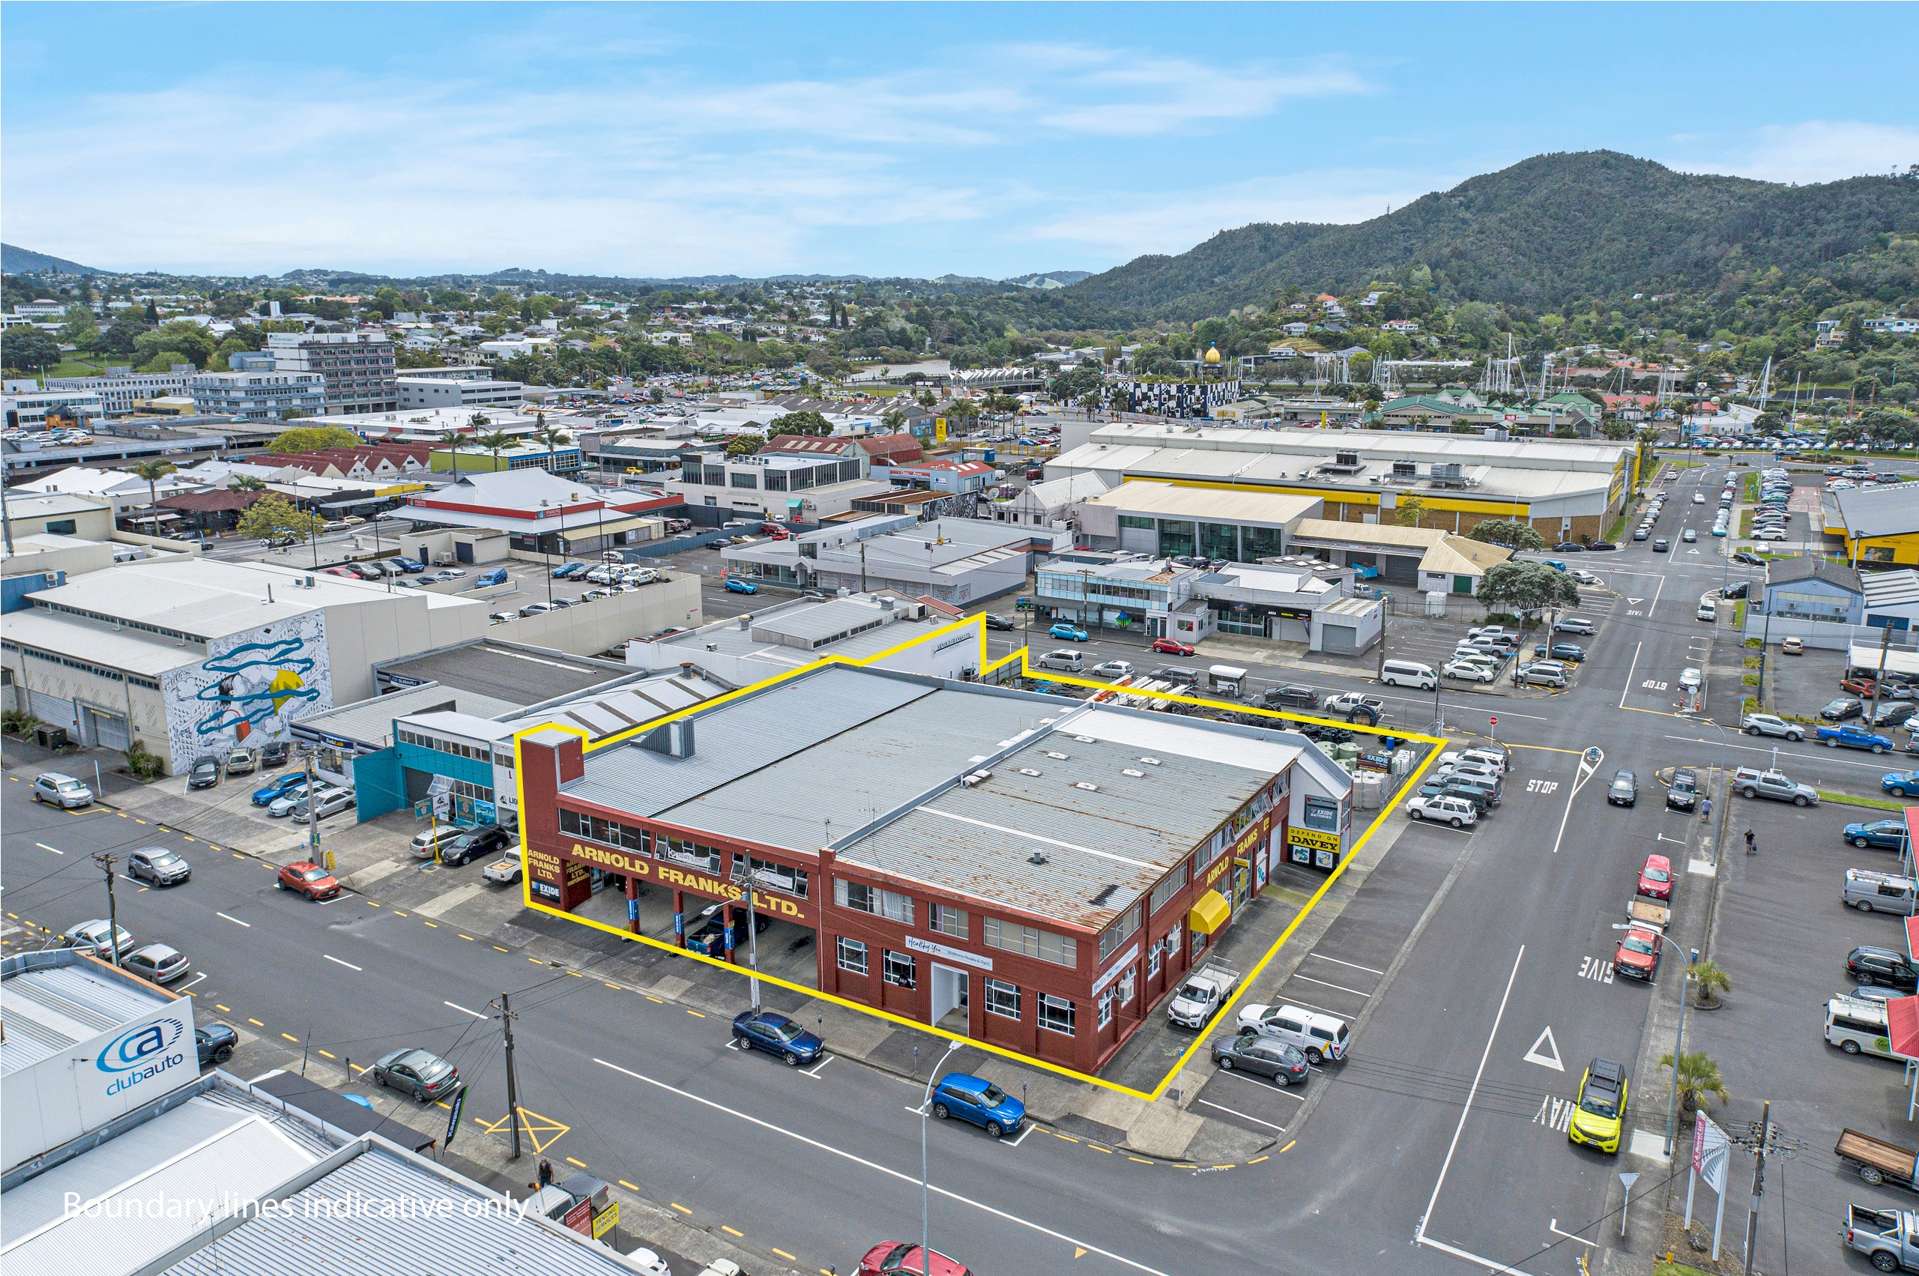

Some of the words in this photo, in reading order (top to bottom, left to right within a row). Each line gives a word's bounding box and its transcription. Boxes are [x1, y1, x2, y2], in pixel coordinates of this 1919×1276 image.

[1642, 679, 1668, 691] STOP
[1526, 779, 1559, 794] STOP
[1290, 828, 1322, 839] DEPEND
[1291, 835, 1338, 851] DAVEY
[528, 849, 560, 865] ARNOLD
[1206, 856, 1229, 886] ARNOLD
[1236, 828, 1258, 856] FRANKS
[528, 857, 560, 874] FRANKS
[537, 868, 554, 880] LTD.
[572, 843, 649, 875] ARNOLD
[658, 866, 742, 901] FRANKS
[752, 892, 805, 919] LTD.
[540, 883, 560, 895] EXIDE
[1577, 955, 1614, 985] GIVE
[106, 1053, 184, 1096] clubauto
[1532, 1095, 1576, 1133] WAY
